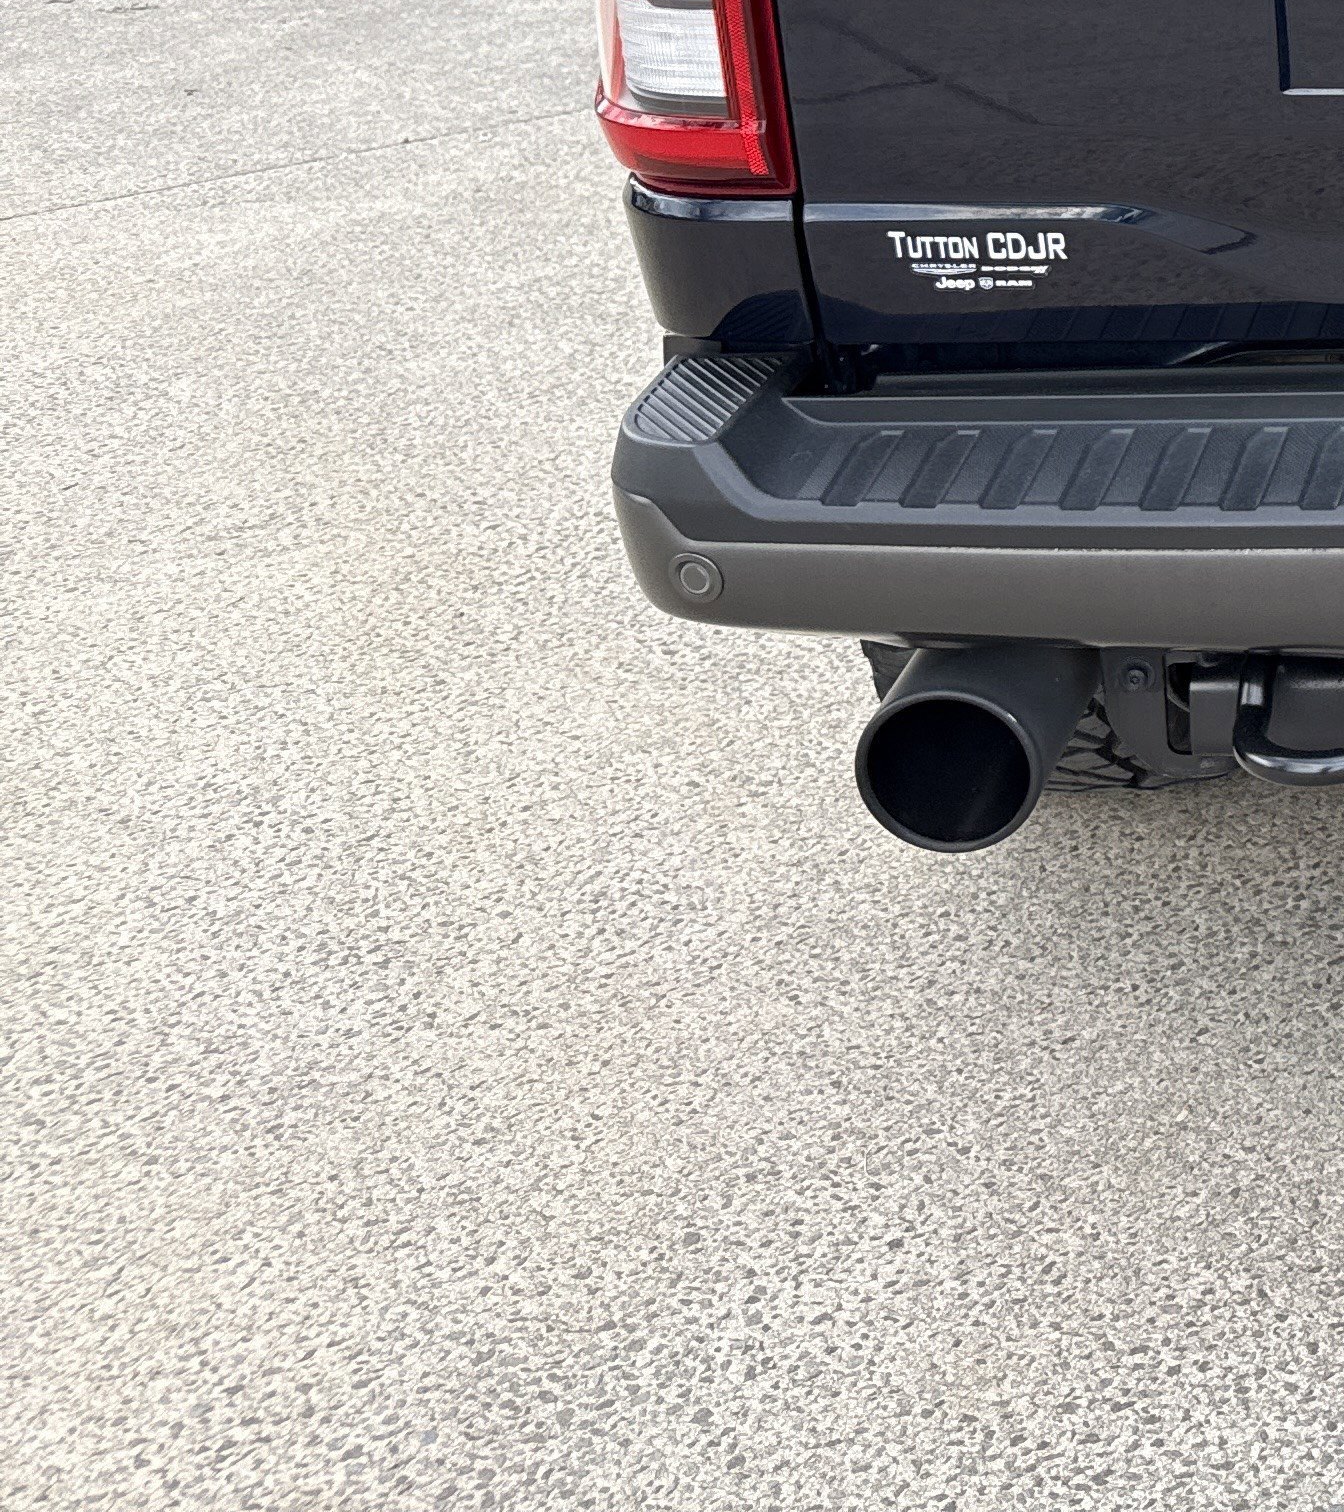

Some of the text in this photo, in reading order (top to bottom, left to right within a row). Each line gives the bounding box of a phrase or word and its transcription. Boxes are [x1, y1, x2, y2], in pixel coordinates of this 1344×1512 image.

[886, 230, 1068, 260] TUTTON CDJR
[934, 276, 976, 290] Jeep
